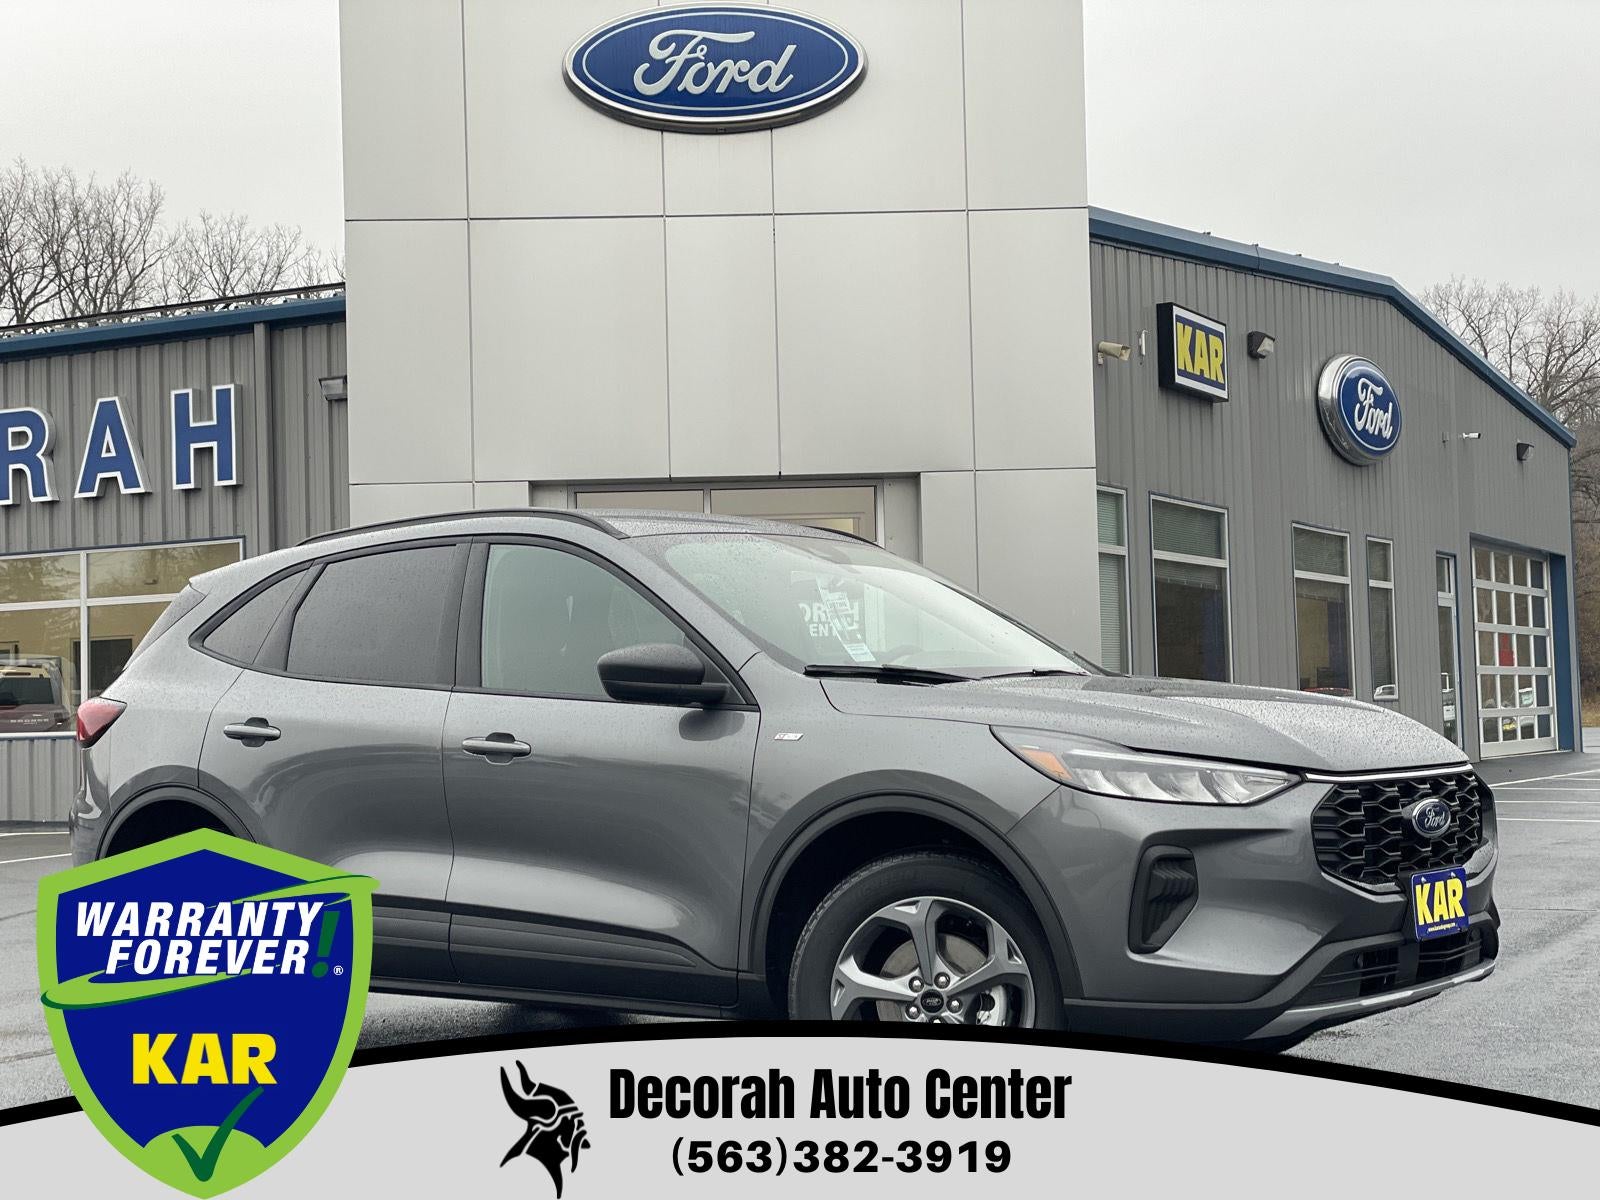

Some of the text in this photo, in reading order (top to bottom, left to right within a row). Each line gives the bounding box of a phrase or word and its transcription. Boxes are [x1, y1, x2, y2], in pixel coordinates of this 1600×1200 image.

[633, 29, 797, 96] Ford
[1176, 321, 1225, 384] KAR
[1354, 377, 1393, 440] Ford
[1424, 806, 1446, 828] Ford
[1415, 877, 1465, 925] KAR
